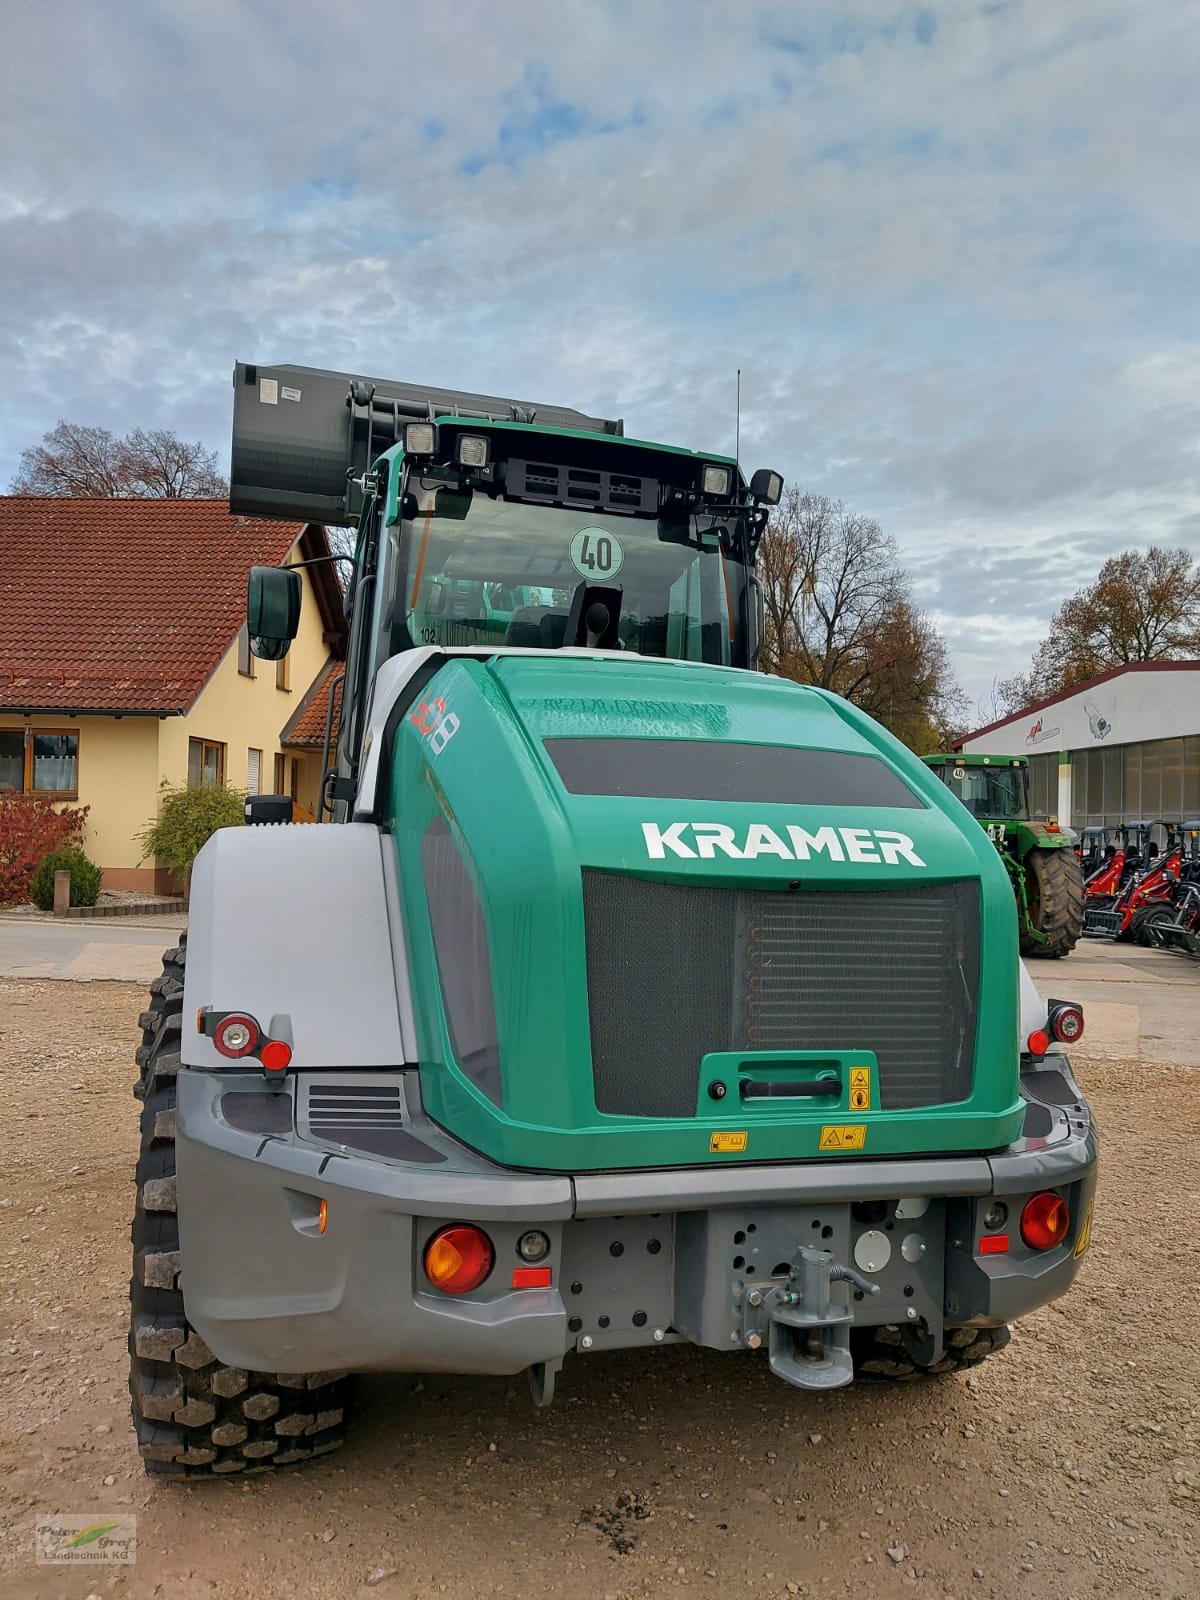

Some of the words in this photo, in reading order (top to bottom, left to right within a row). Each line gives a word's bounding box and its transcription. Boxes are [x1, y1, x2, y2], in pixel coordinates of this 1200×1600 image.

[580, 535, 612, 571] 40
[420, 628, 436, 644] 102
[641, 822, 928, 867] KRAMER
